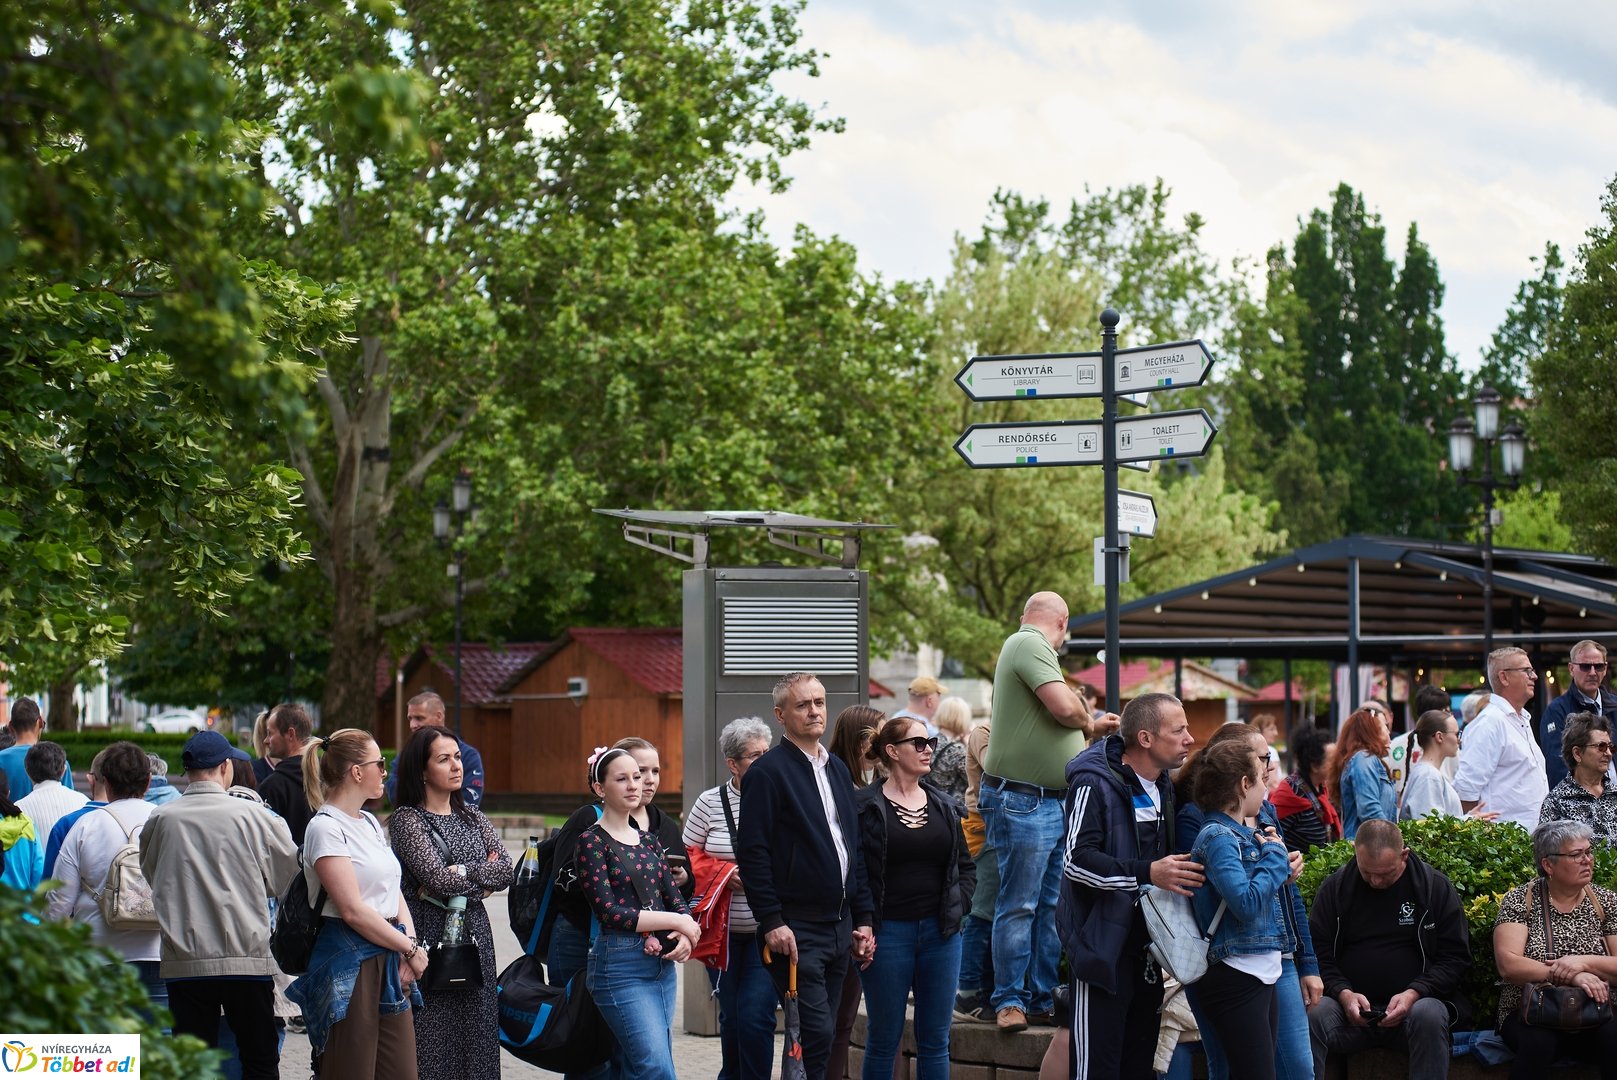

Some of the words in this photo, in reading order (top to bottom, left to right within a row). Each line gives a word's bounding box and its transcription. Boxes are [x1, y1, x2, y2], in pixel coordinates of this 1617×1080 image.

[1144, 353, 1185, 367] MEGYEHÁZA
[1001, 364, 1054, 376] KÖNYVTÁR
[1013, 378, 1041, 386] LIBRARY
[1152, 424, 1180, 436] TOALETT
[1158, 437, 1174, 445] TOILET
[1015, 445, 1039, 453] POLICE
